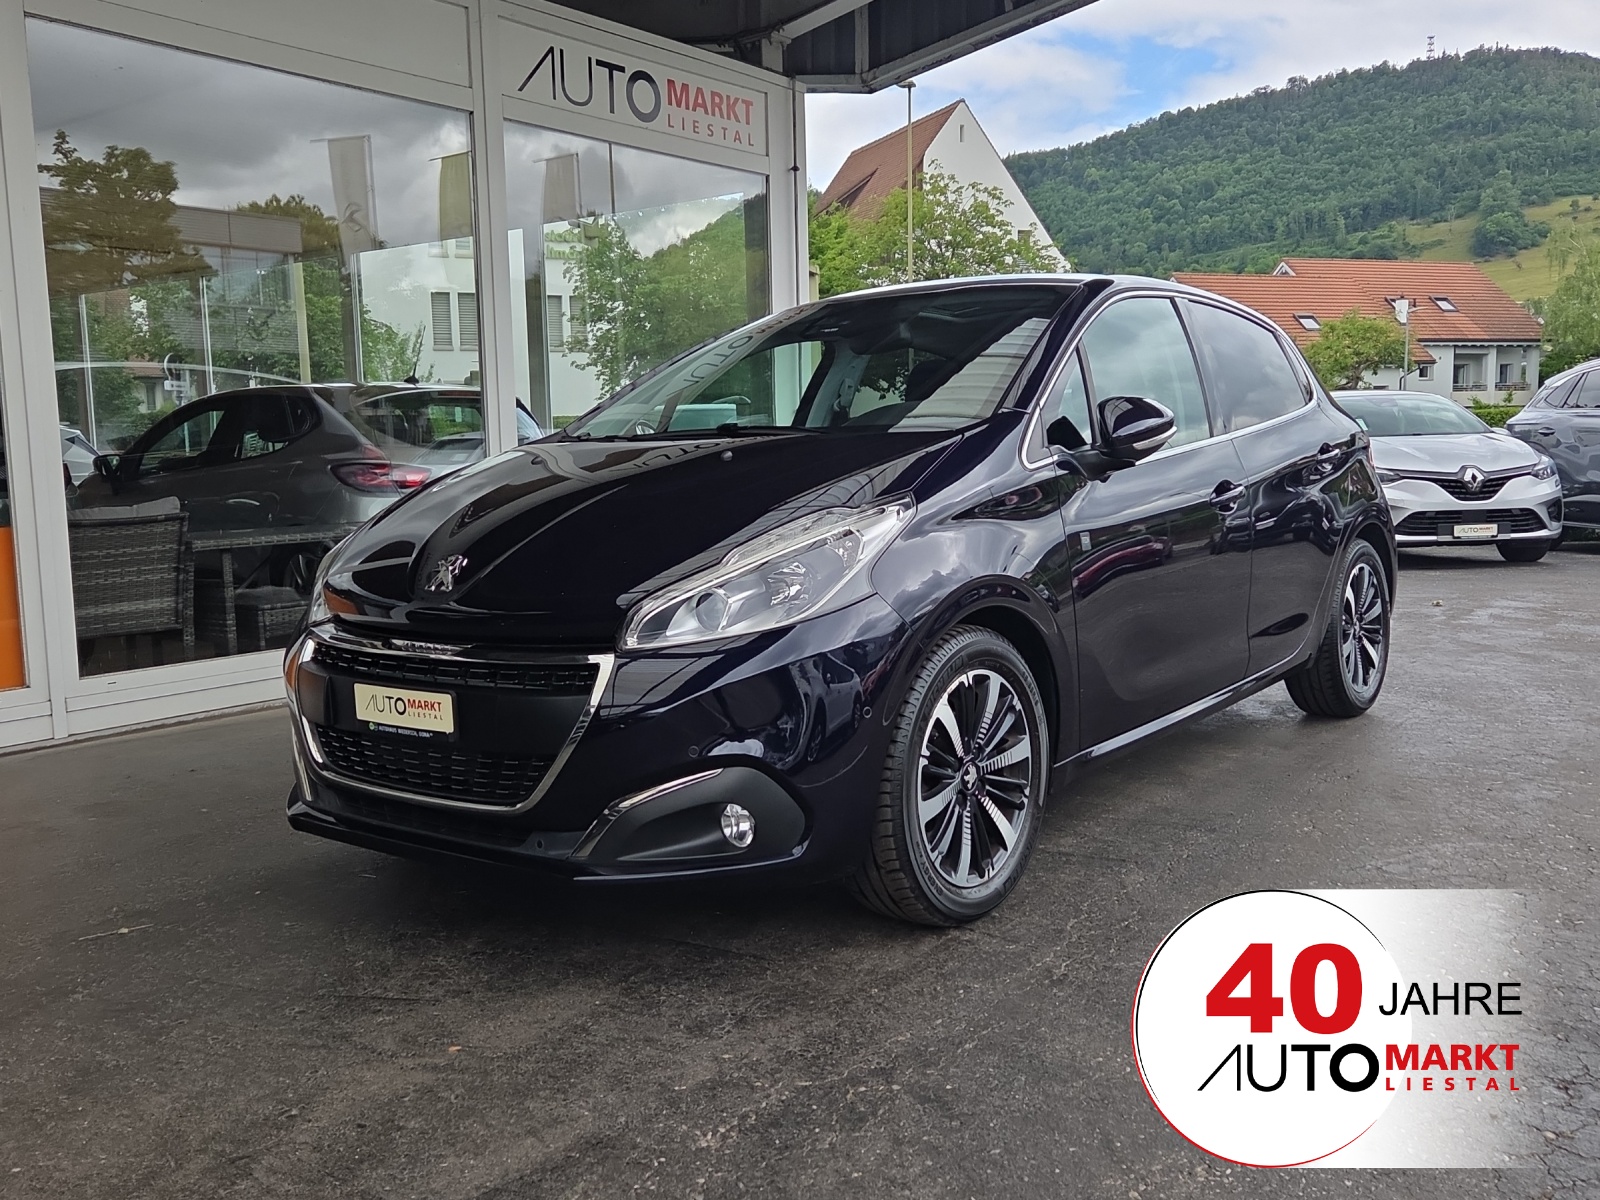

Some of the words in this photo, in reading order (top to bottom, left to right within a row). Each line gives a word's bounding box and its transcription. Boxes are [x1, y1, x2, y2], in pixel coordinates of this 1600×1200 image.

[517, 45, 662, 123] AUTO
[666, 78, 754, 126] MARKT
[667, 113, 755, 147] LIESTAL
[365, 694, 407, 716] AUTO
[407, 698, 442, 712] MARKT
[408, 711, 443, 721] LIESTAL
